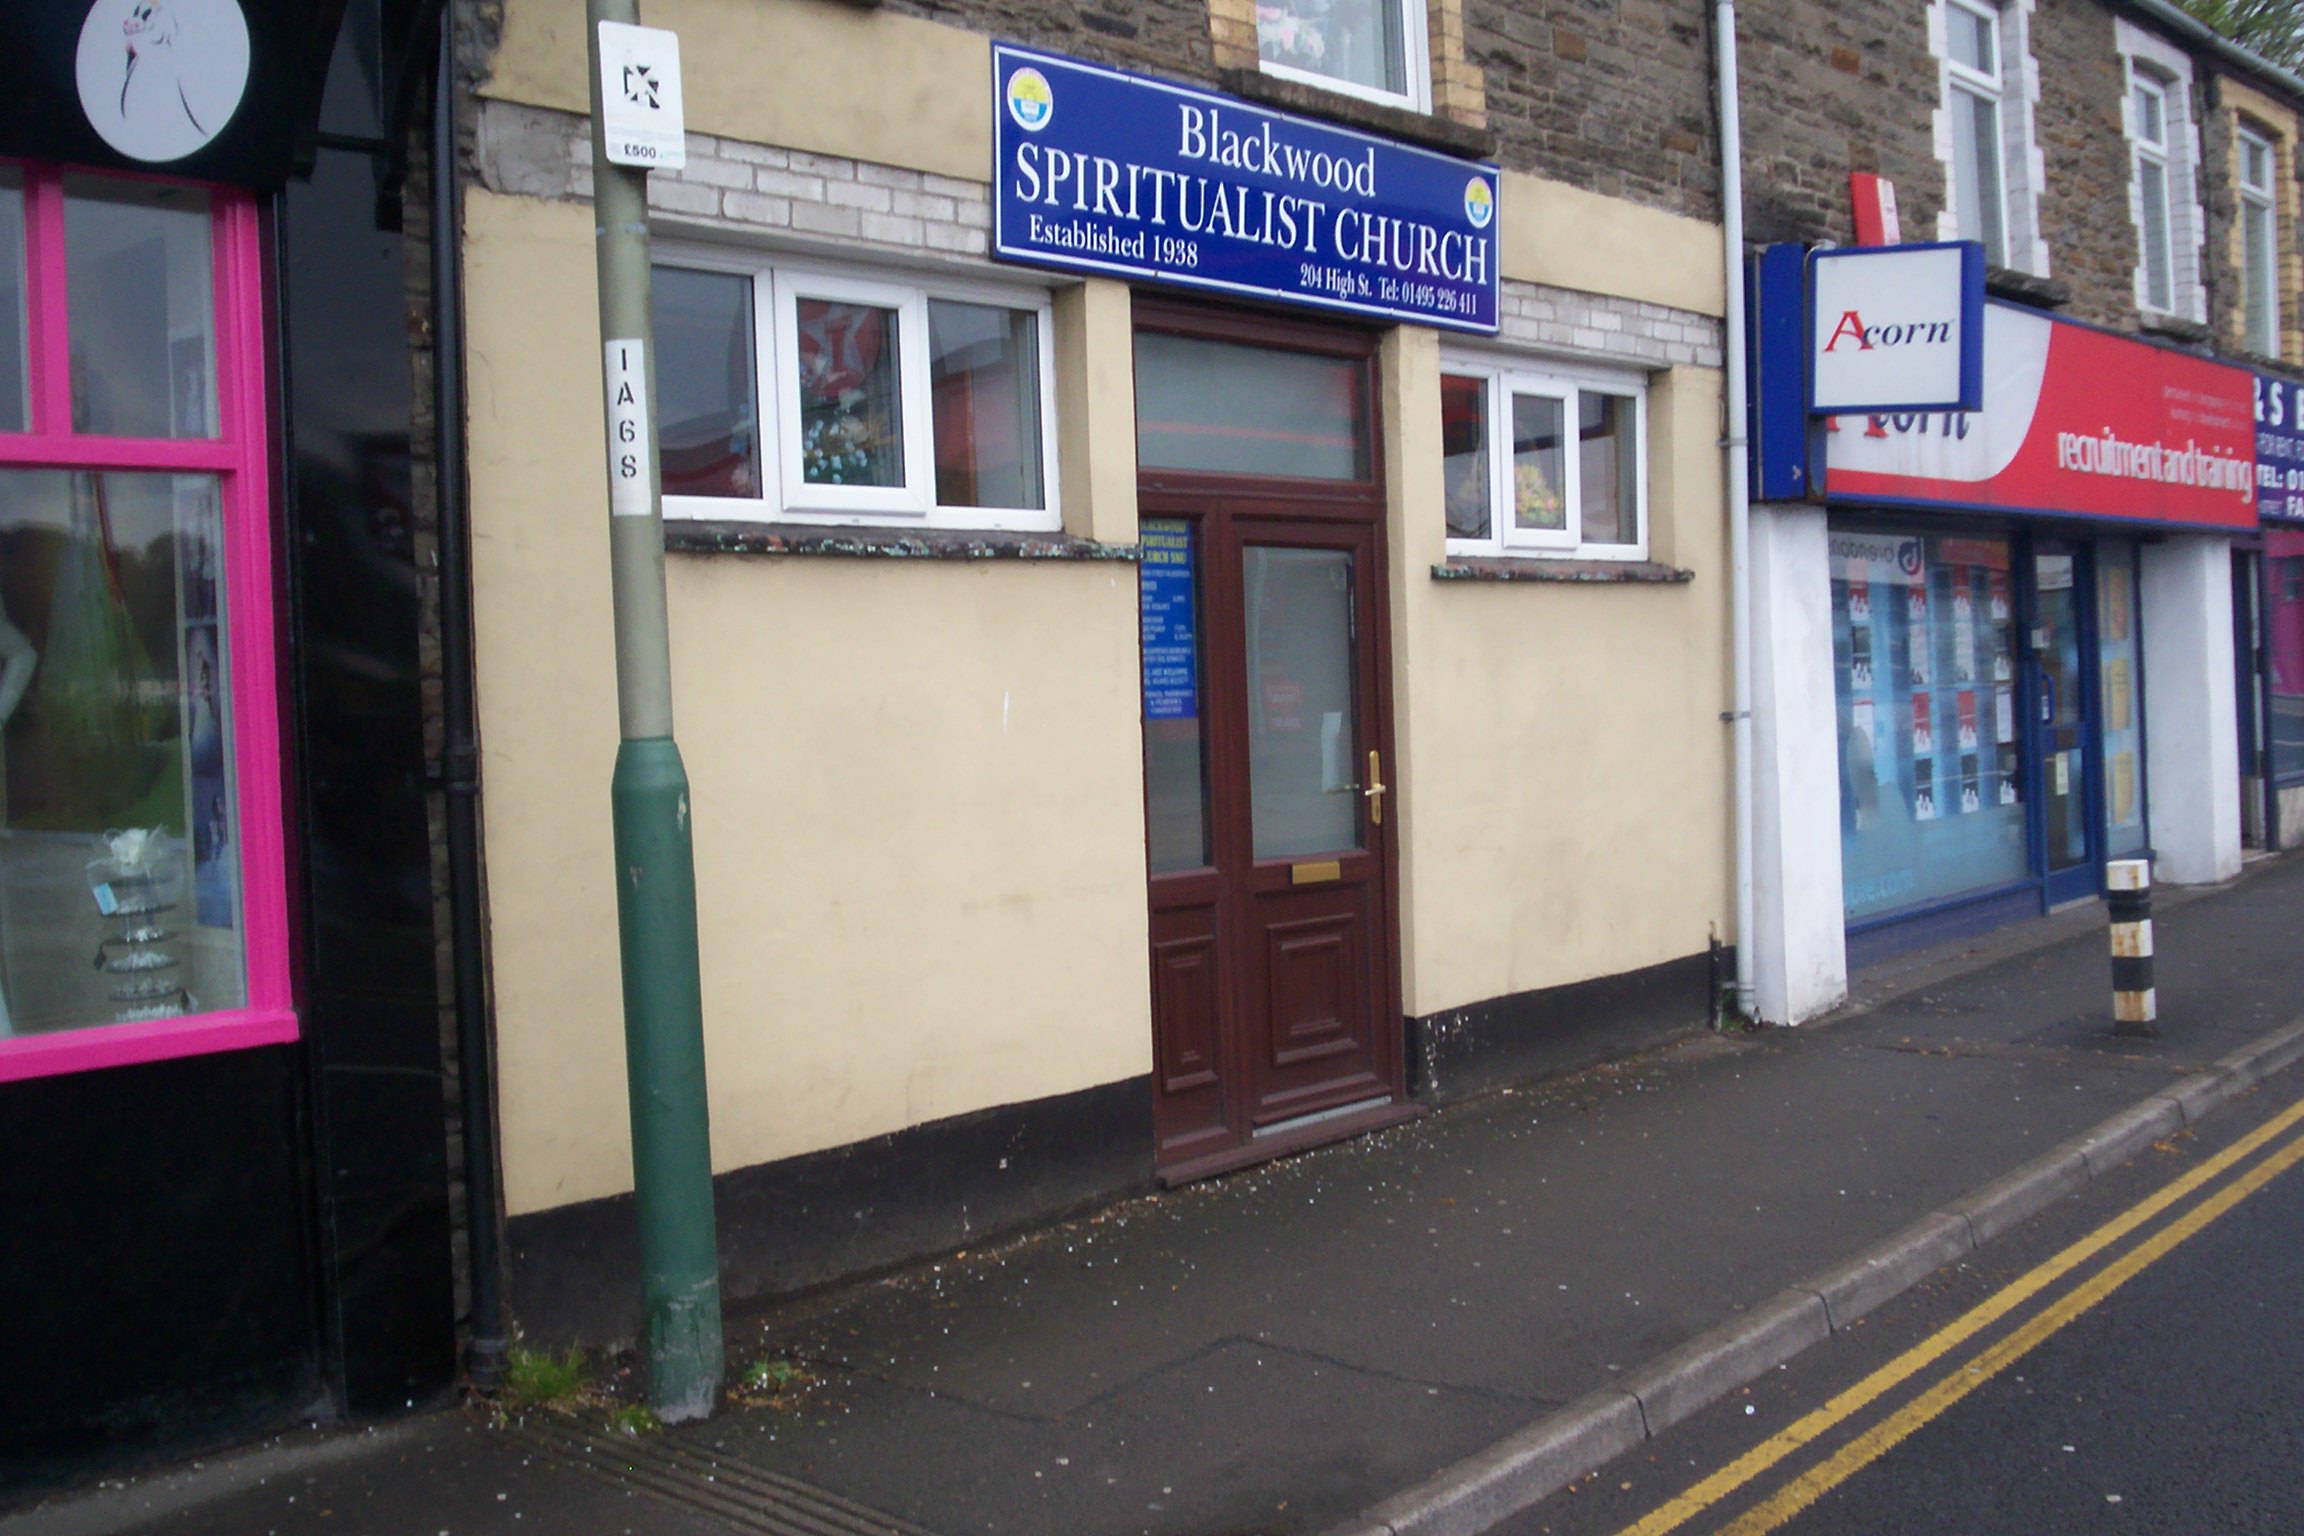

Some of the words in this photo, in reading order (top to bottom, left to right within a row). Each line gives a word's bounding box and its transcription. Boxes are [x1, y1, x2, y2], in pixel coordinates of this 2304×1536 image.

[1178, 103, 1376, 197] Blackwood
[1016, 142, 1326, 253] SPIRITUALIST
[1334, 208, 1488, 286] CHURCH
[1030, 214, 1145, 259] Established
[1154, 235, 1198, 268] 1938
[1300, 263, 1322, 289] 204
[1326, 267, 1355, 299] High
[1357, 273, 1373, 297] St.
[1378, 276, 1399, 301] Tel:
[1402, 282, 1435, 308] 01495
[1437, 288, 1456, 312] 226
[1458, 292, 1477, 316] 411
[1822, 310, 1952, 352] Acorn
[2270, 381, 2284, 426] S
[2058, 426, 2163, 482] recruitment
[2196, 445, 2253, 504] training
